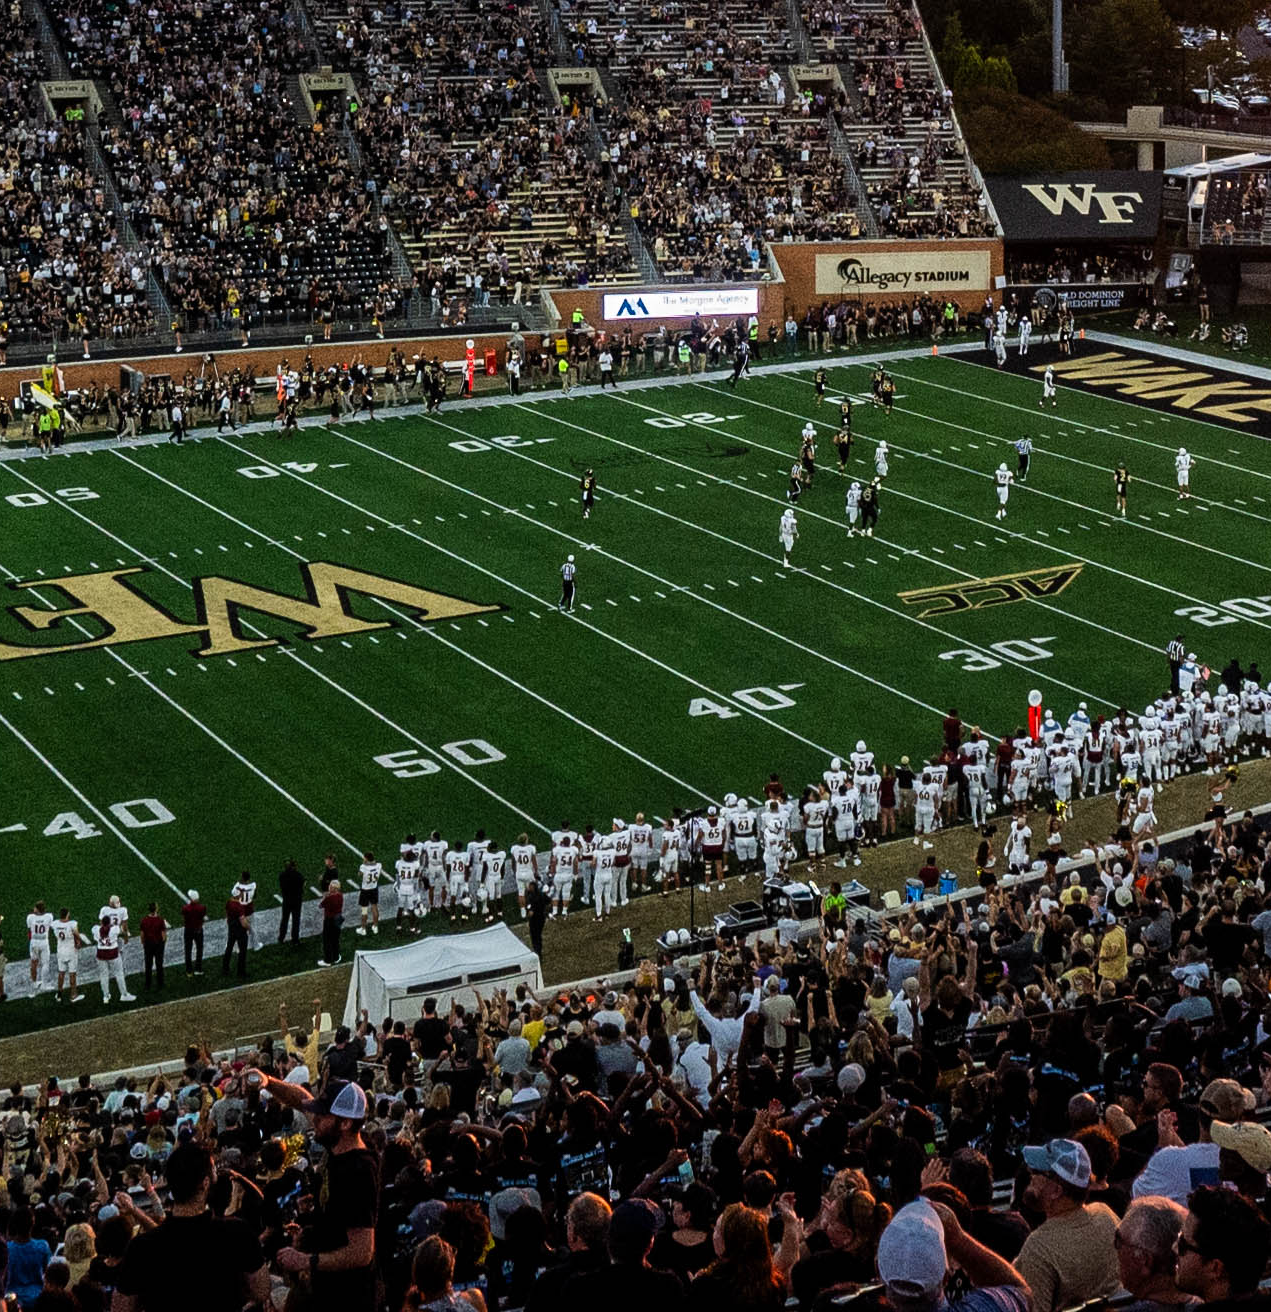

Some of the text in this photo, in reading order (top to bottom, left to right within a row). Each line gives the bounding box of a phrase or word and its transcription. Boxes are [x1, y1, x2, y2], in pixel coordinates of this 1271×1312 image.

[1021, 183, 1144, 224] WF
[842, 259, 970, 289] Allegacy STADIUM
[1067, 299, 1121, 308] REIGHT LINE
[1078, 290, 1125, 299] DOMINION
[643, 411, 726, 430] 20
[447, 435, 534, 453] 30
[235, 461, 321, 481] 40
[3, 485, 102, 508] 50
[937, 638, 1055, 672] 30
[687, 687, 798, 721] 40
[373, 738, 508, 780] 50
[42, 797, 178, 840] 40
[452, 860, 464, 872] 28
[493, 861, 499, 873] 0
[517, 854, 530, 865] 40
[366, 871, 379, 884] 35
[34, 924, 46, 935] 10
[58, 931, 66, 941] 9
